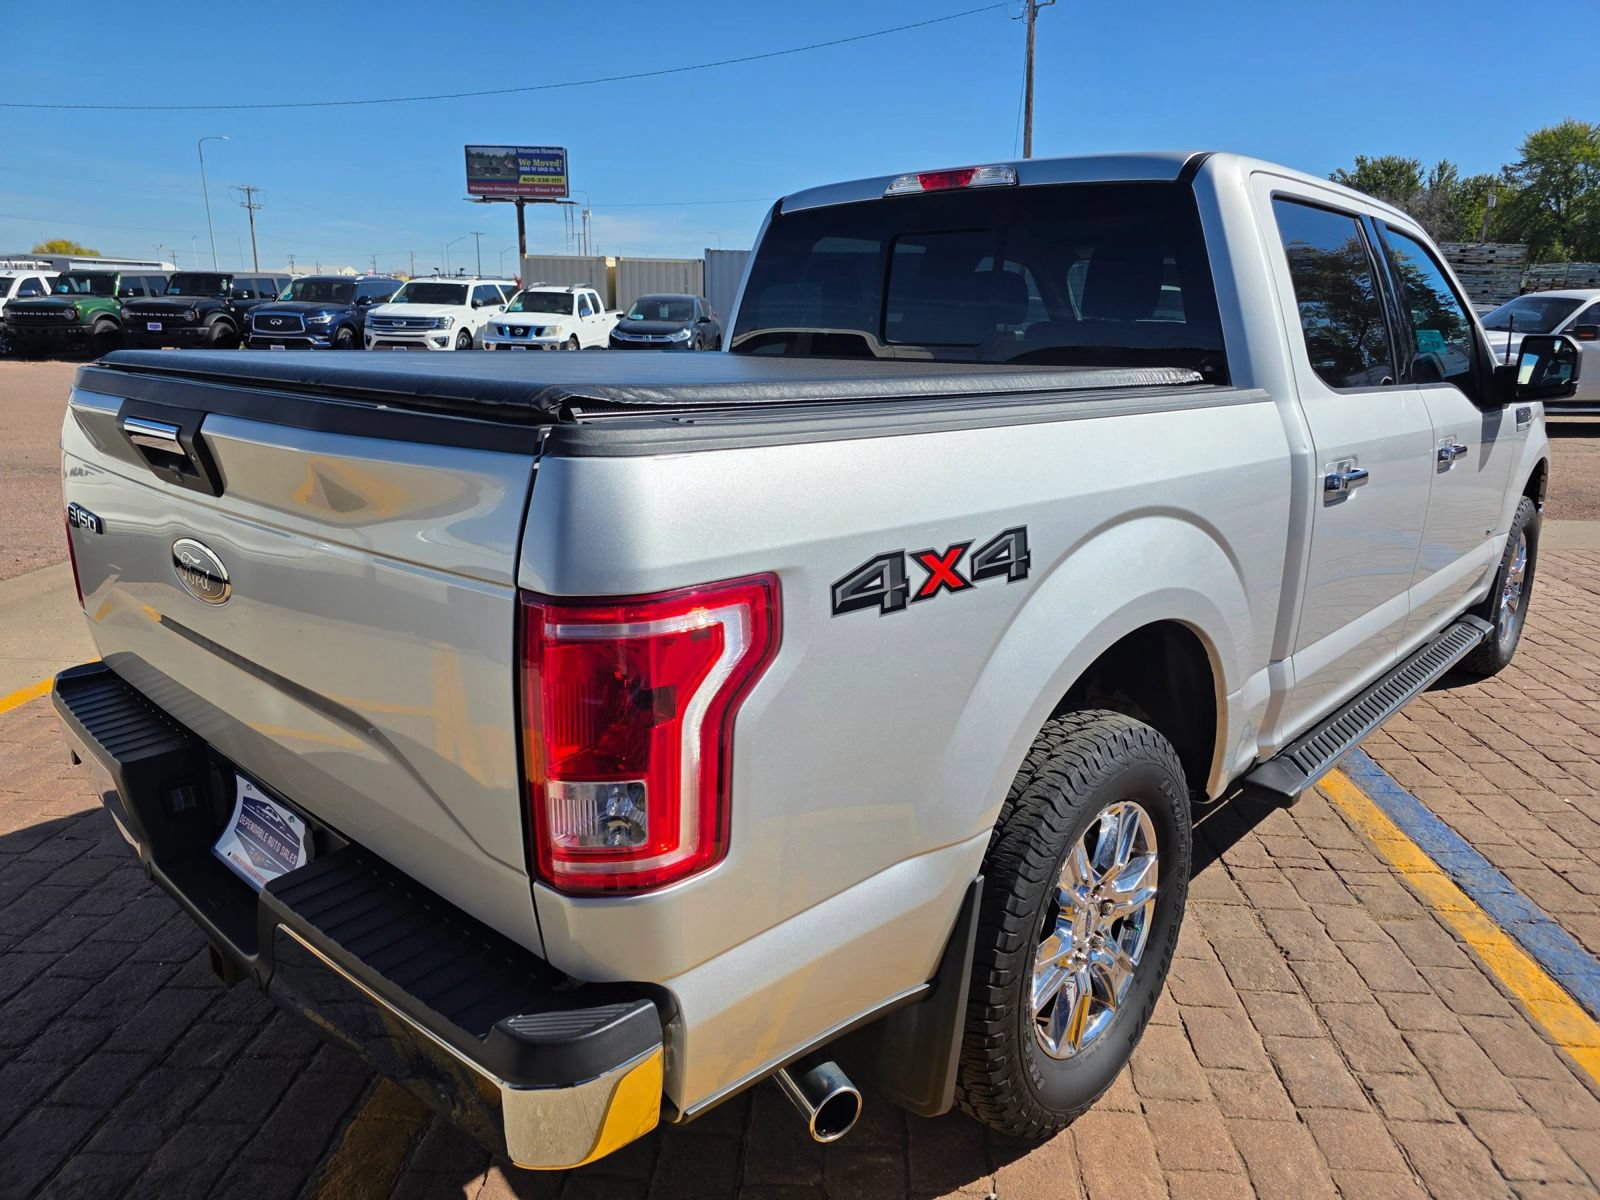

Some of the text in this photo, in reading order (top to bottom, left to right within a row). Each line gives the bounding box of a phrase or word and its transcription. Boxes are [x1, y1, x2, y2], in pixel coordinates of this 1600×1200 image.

[518, 158, 562, 167] We Moved!
[178, 550, 212, 592] Ford
[239, 814, 268, 842] DEPENDABLE
[267, 834, 283, 853] AUTO
[279, 844, 298, 866] SALES
